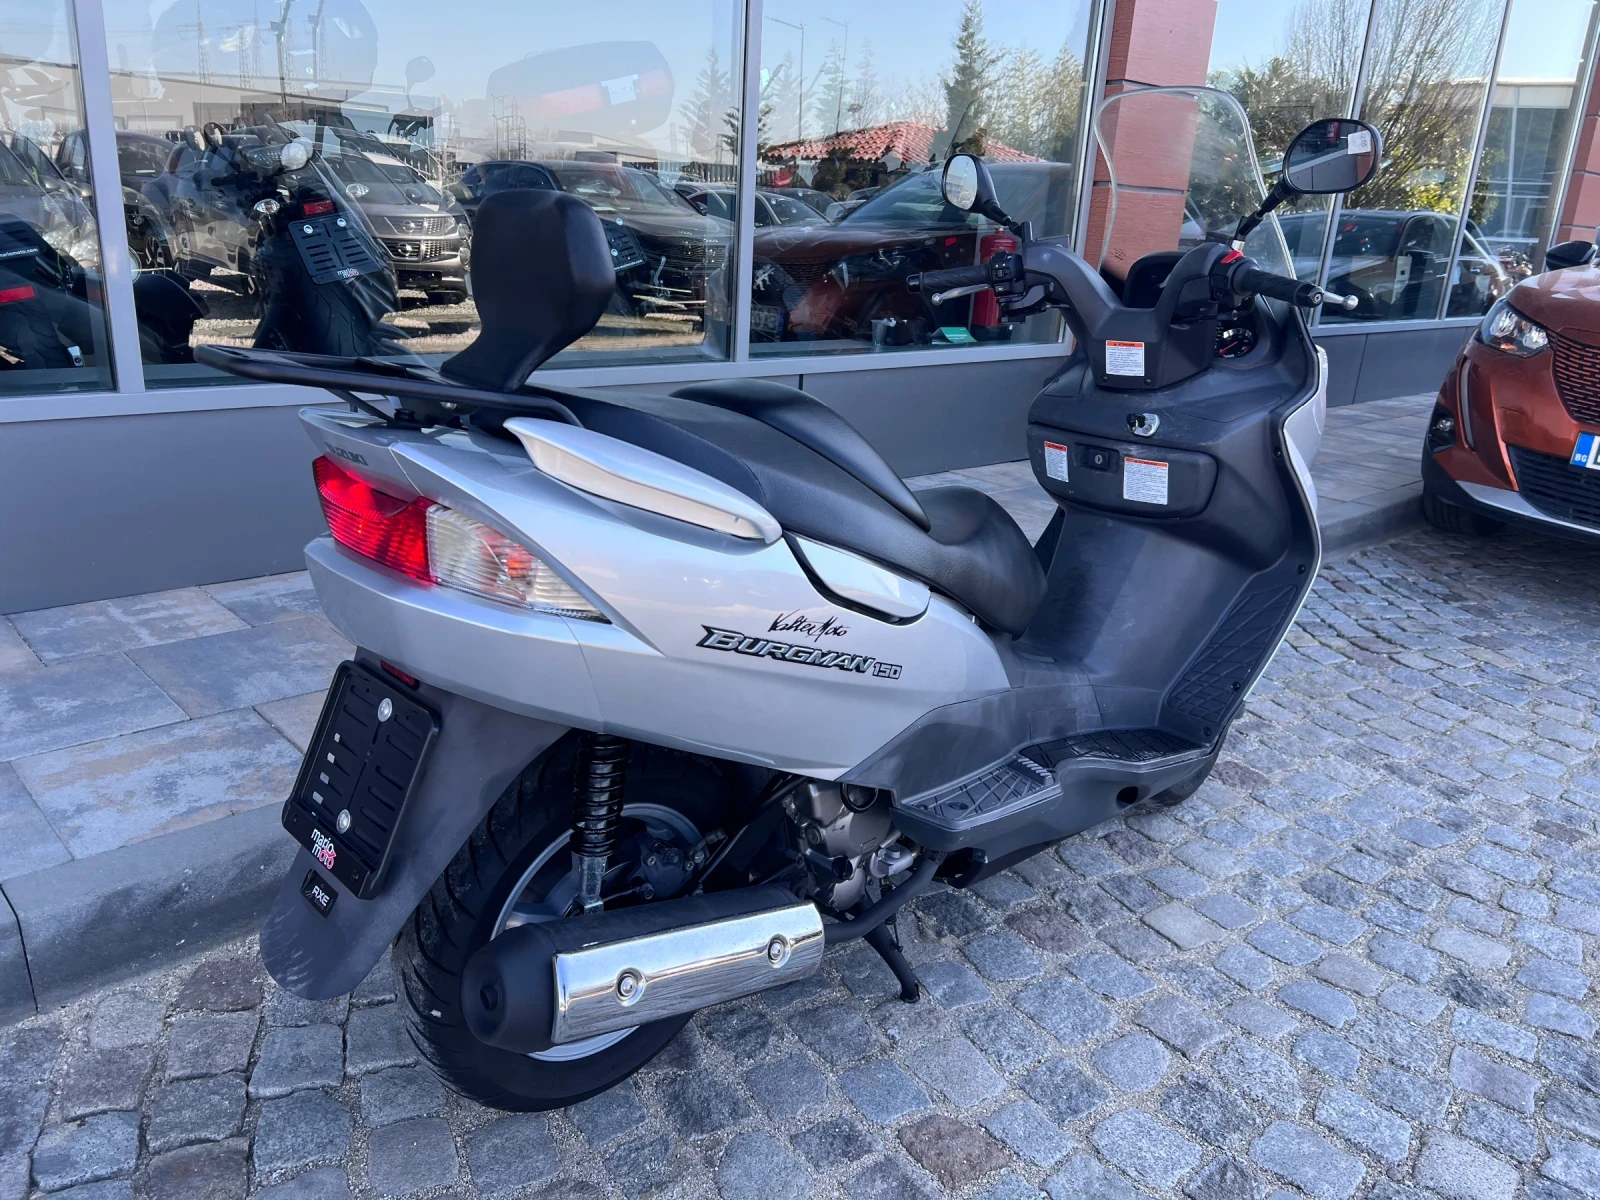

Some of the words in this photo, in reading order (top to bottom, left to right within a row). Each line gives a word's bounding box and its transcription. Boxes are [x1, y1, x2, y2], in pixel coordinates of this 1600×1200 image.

[1575, 453, 1588, 462] BG
[872, 661, 903, 680] 150
[311, 828, 335, 854] mario
[311, 843, 336, 869] moto
[311, 885, 330, 907] AXE
